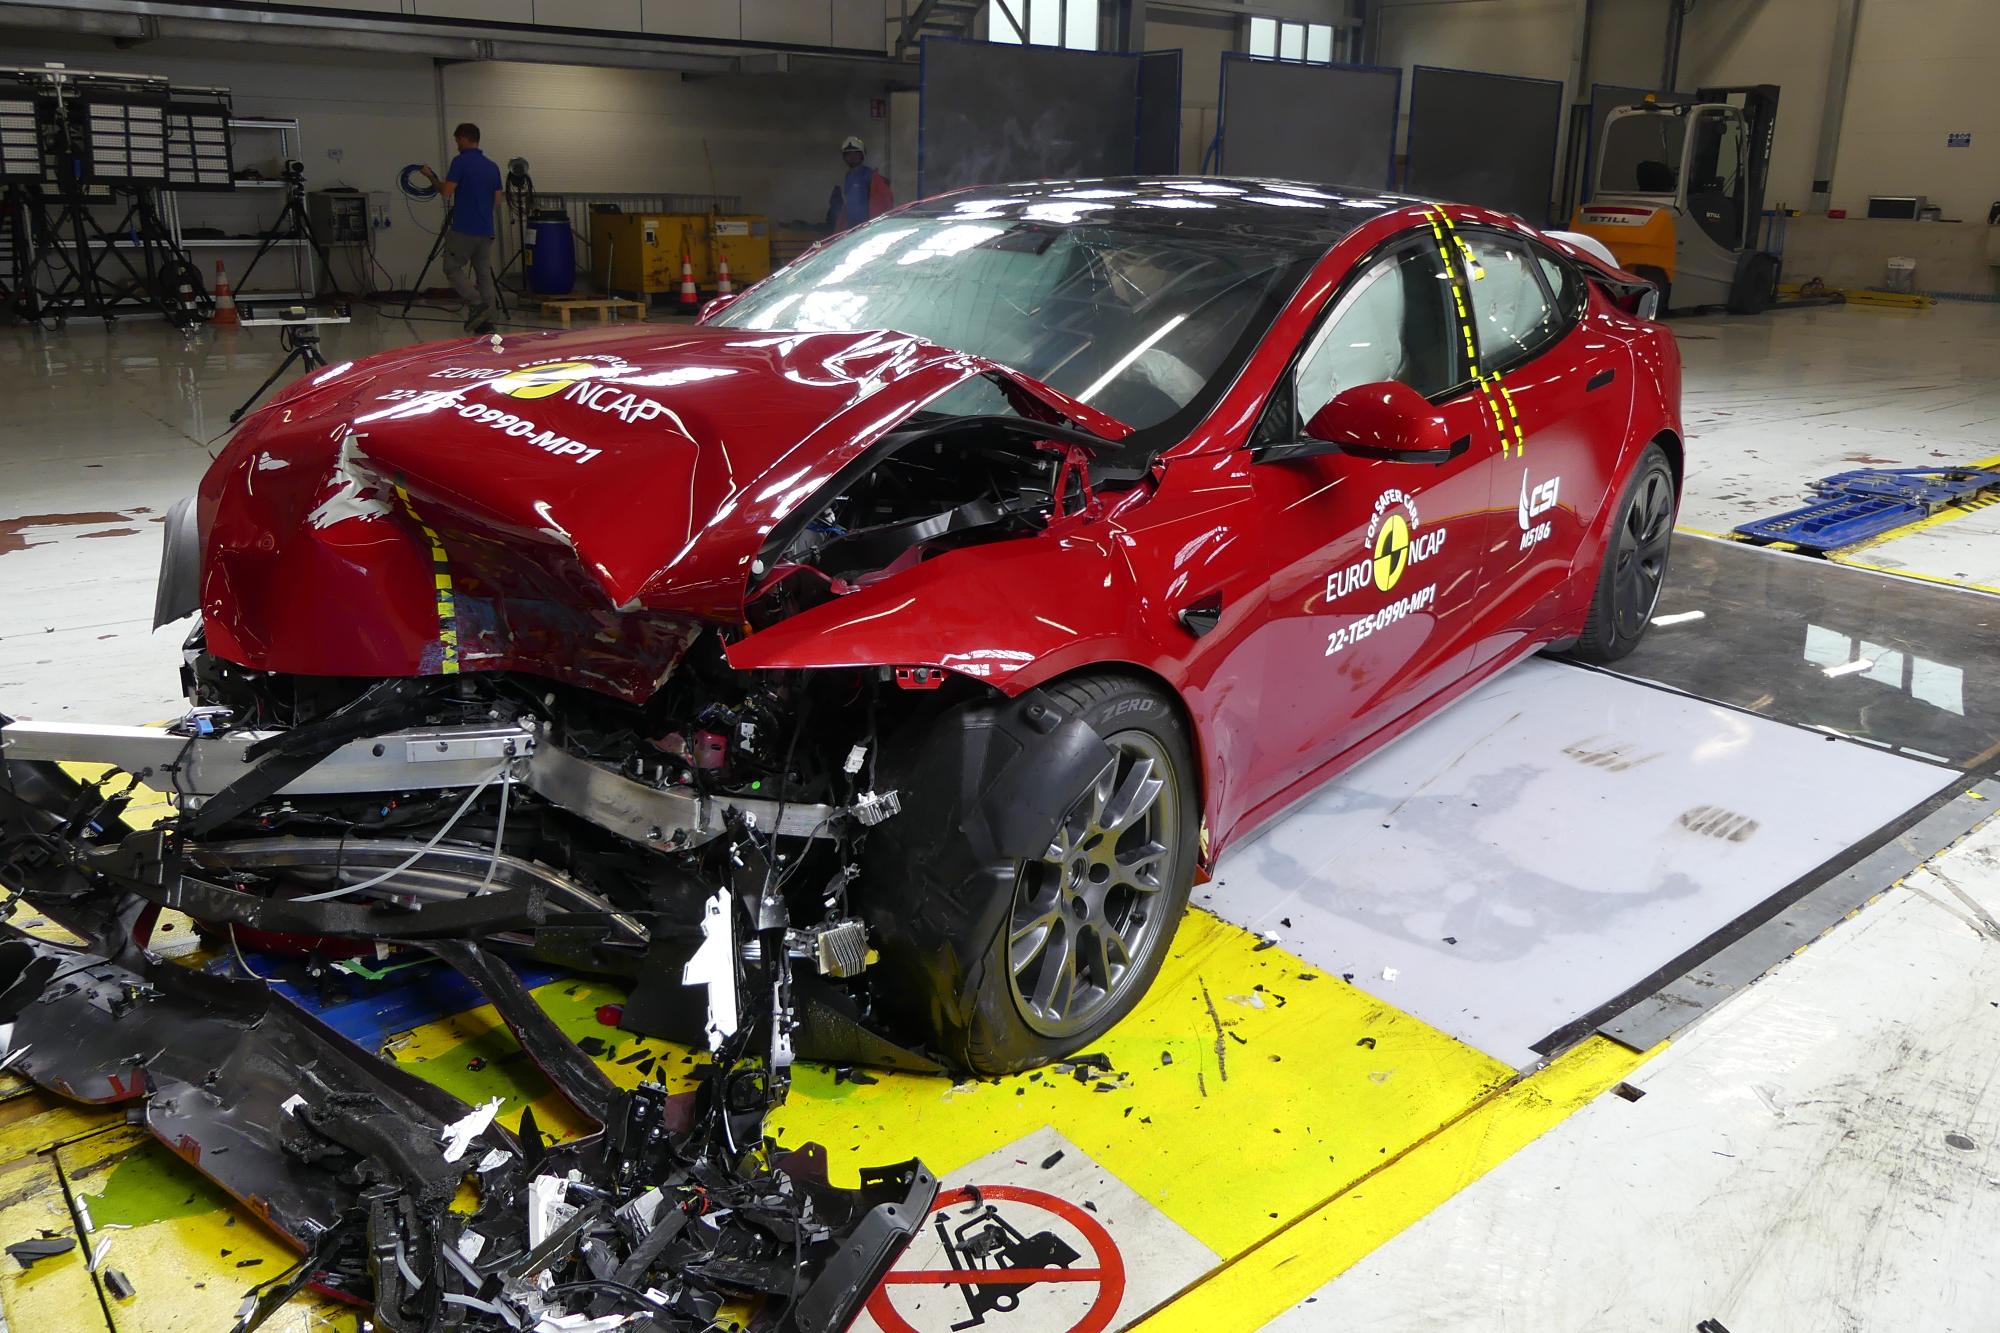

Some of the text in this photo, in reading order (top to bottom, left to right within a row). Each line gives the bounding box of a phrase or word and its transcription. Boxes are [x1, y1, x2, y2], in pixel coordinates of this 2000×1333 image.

[1589, 215, 1630, 224] STILL
[428, 367, 512, 379] EURO
[518, 357, 562, 368] FOR
[564, 381, 662, 423] NCAP
[376, 389, 602, 464] 22-TS-0990-MP1
[1528, 476, 1560, 518] CSI
[1364, 488, 1419, 549] FOR SAFER CARS
[1408, 528, 1446, 566] NCAP
[1325, 559, 1372, 603] EURO
[1325, 583, 1436, 656] 22-TES-0990-MP1
[1101, 698, 1154, 724] ZERO
